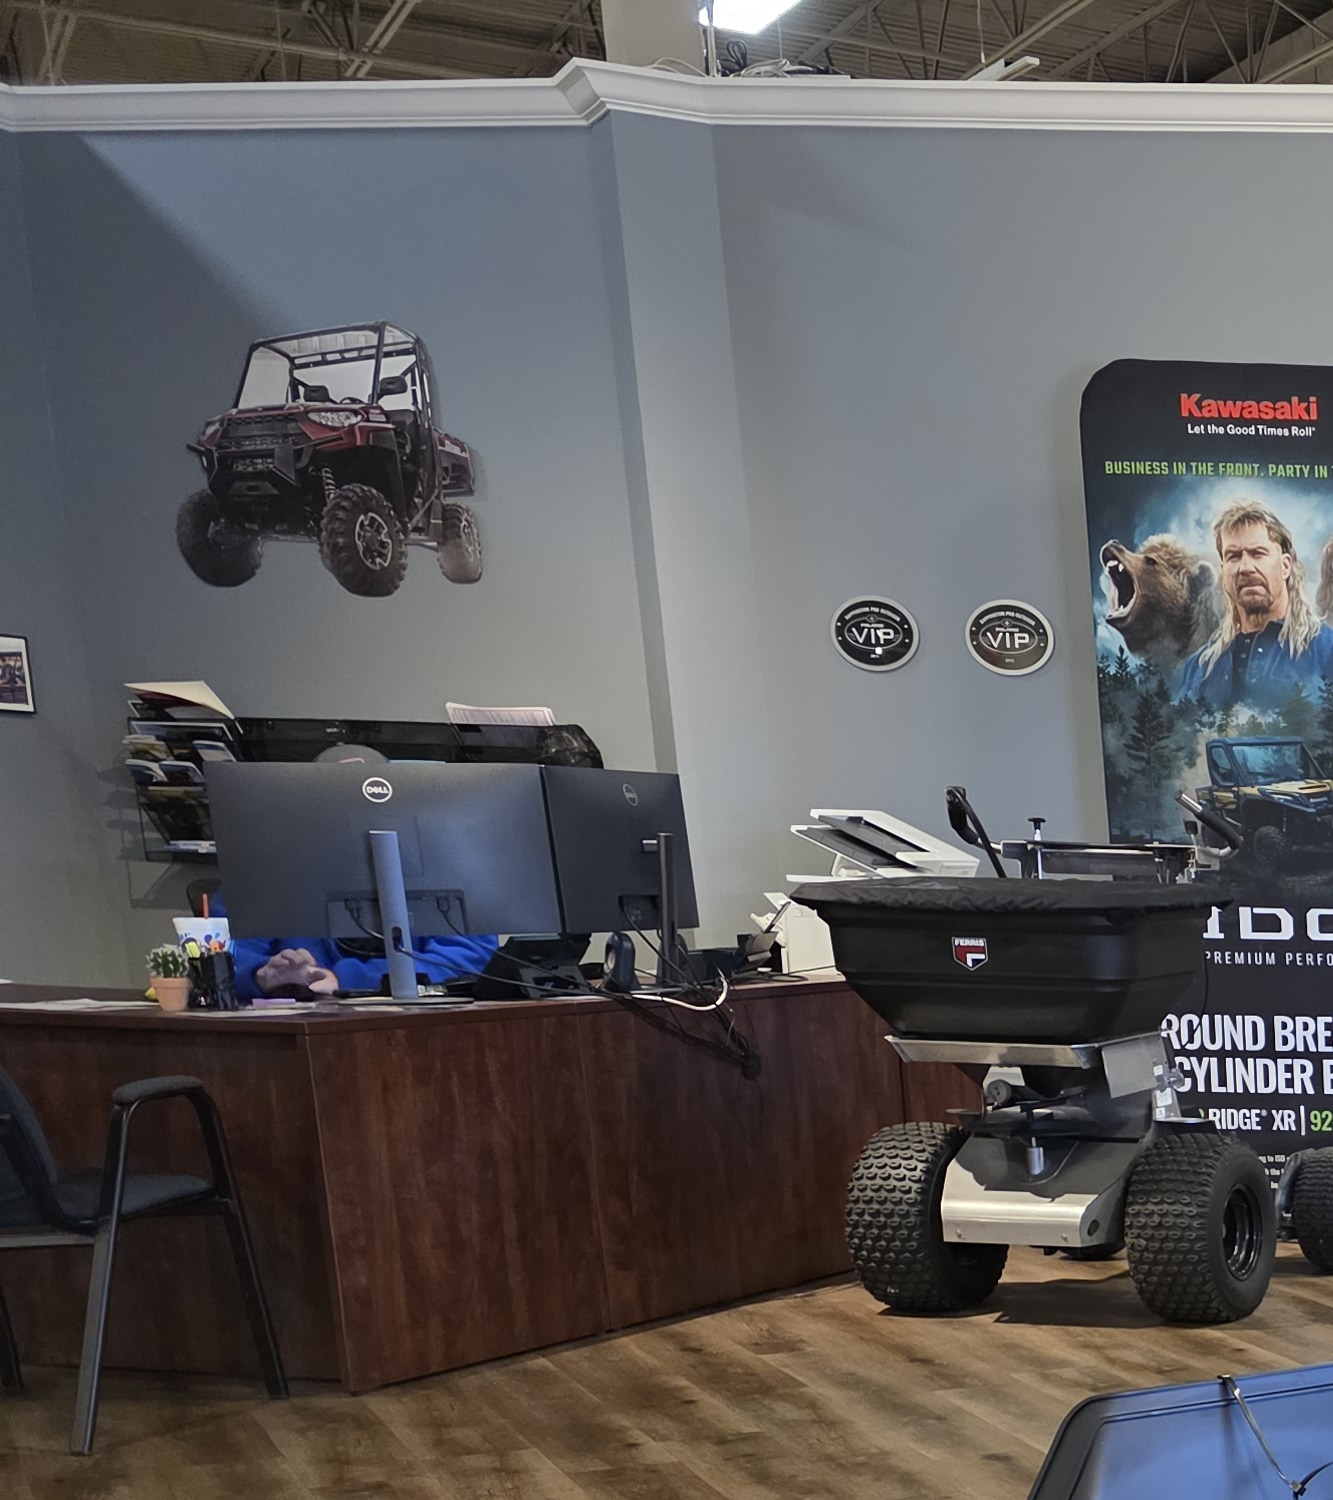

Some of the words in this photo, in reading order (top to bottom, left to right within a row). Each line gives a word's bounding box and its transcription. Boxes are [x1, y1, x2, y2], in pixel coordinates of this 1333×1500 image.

[1180, 394, 1318, 421] Kawasaki
[1188, 424, 1205, 435] Let
[1207, 424, 1225, 436] the
[1226, 425, 1255, 436] Good
[1257, 425, 1290, 437] Times
[1105, 461, 1169, 476] BUSINESS
[1173, 462, 1187, 476] IN
[1190, 462, 1214, 477] THE
[1218, 463, 1264, 477] FRONT.
[1268, 464, 1310, 479] PARTY
[1314, 465, 1328, 479] IN
[851, 627, 894, 645] VIP
[986, 632, 1030, 649] VIP
[366, 786, 389, 794] DELL
[955, 938, 984, 946] FERRIS
[1162, 1013, 1266, 1051] ROUND
[1271, 1110, 1297, 1132] XR
